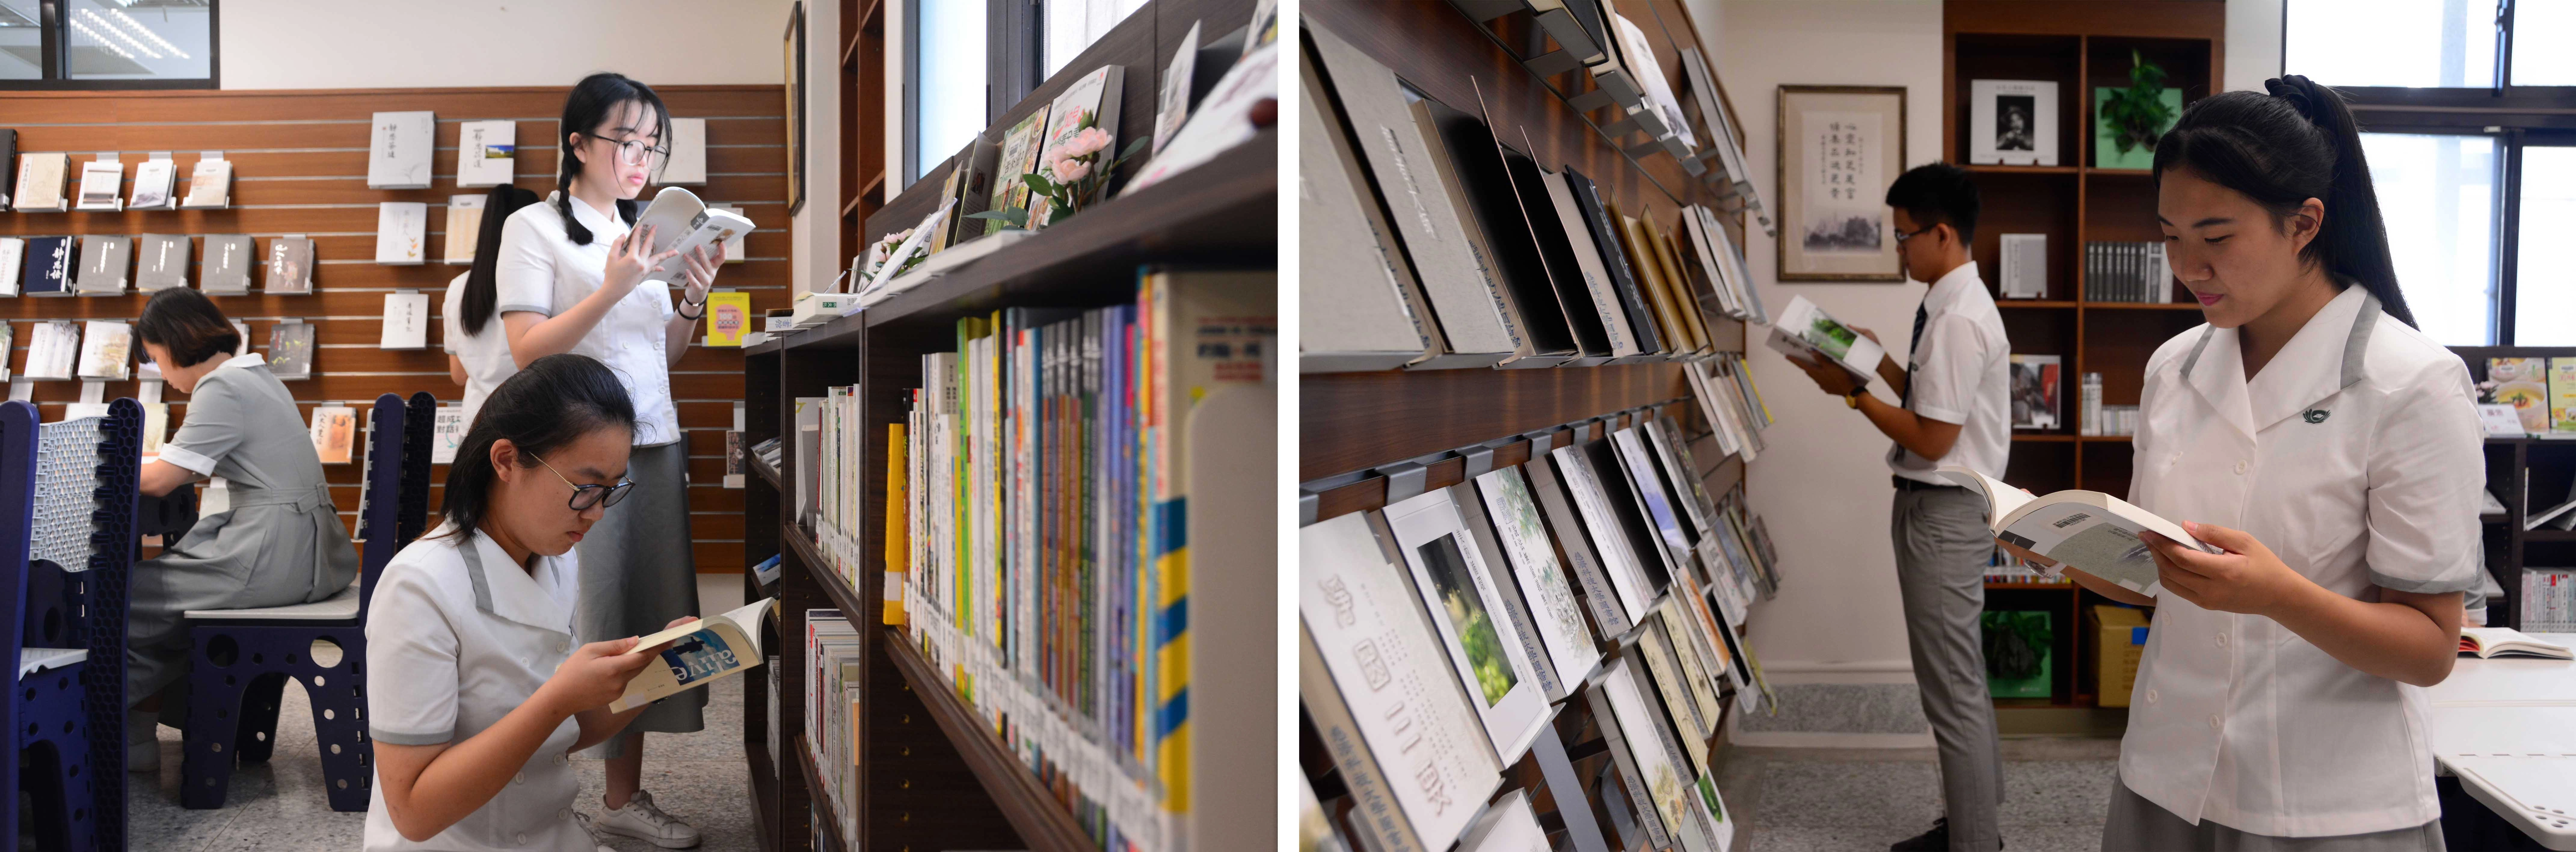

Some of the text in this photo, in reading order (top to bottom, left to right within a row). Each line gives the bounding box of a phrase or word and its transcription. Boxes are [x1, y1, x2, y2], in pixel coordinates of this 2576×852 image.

[775, 319, 792, 328] 書館
[1511, 524, 1554, 620] 說法無量義無量
[1575, 552, 1619, 626] 慈濟科技大學圖書館
[671, 649, 737, 681] alive
[1505, 598, 1552, 692] 慈濟科技大學圖書館
[1330, 724, 1411, 852] 慈濟科技大學圖書
